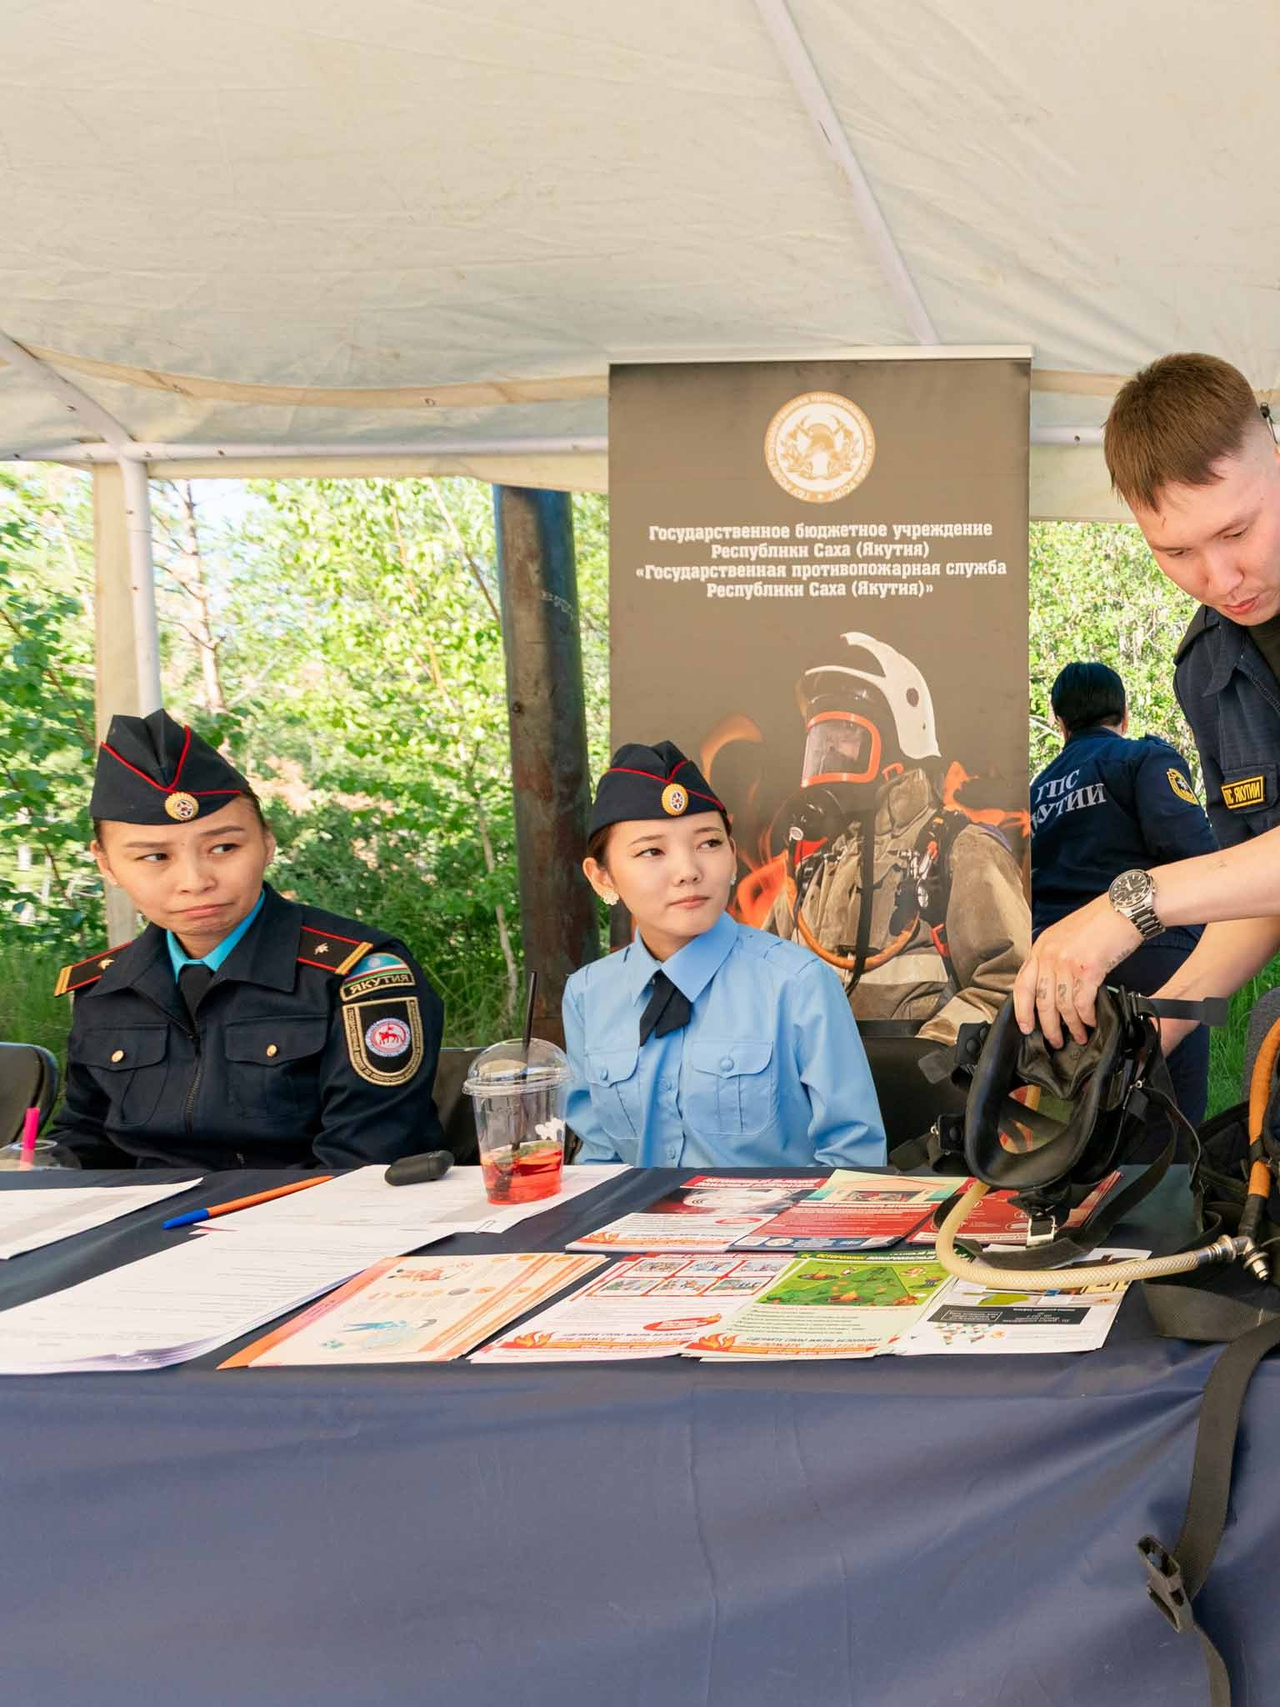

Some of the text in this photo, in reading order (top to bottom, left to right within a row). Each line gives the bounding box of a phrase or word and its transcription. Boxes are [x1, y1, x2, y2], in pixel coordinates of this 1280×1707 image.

[649, 522, 993, 544] Государственное бюджетное учреждение
[711, 541, 930, 561] Республики Саха (Якутия)
[635, 559, 1007, 583] «Государственная противопожарная служба
[706, 579, 934, 600] Республики Саха (Якутия)»
[1035, 769, 1080, 804] ГПС
[349, 974, 410, 994] ЯКУТИЯ
